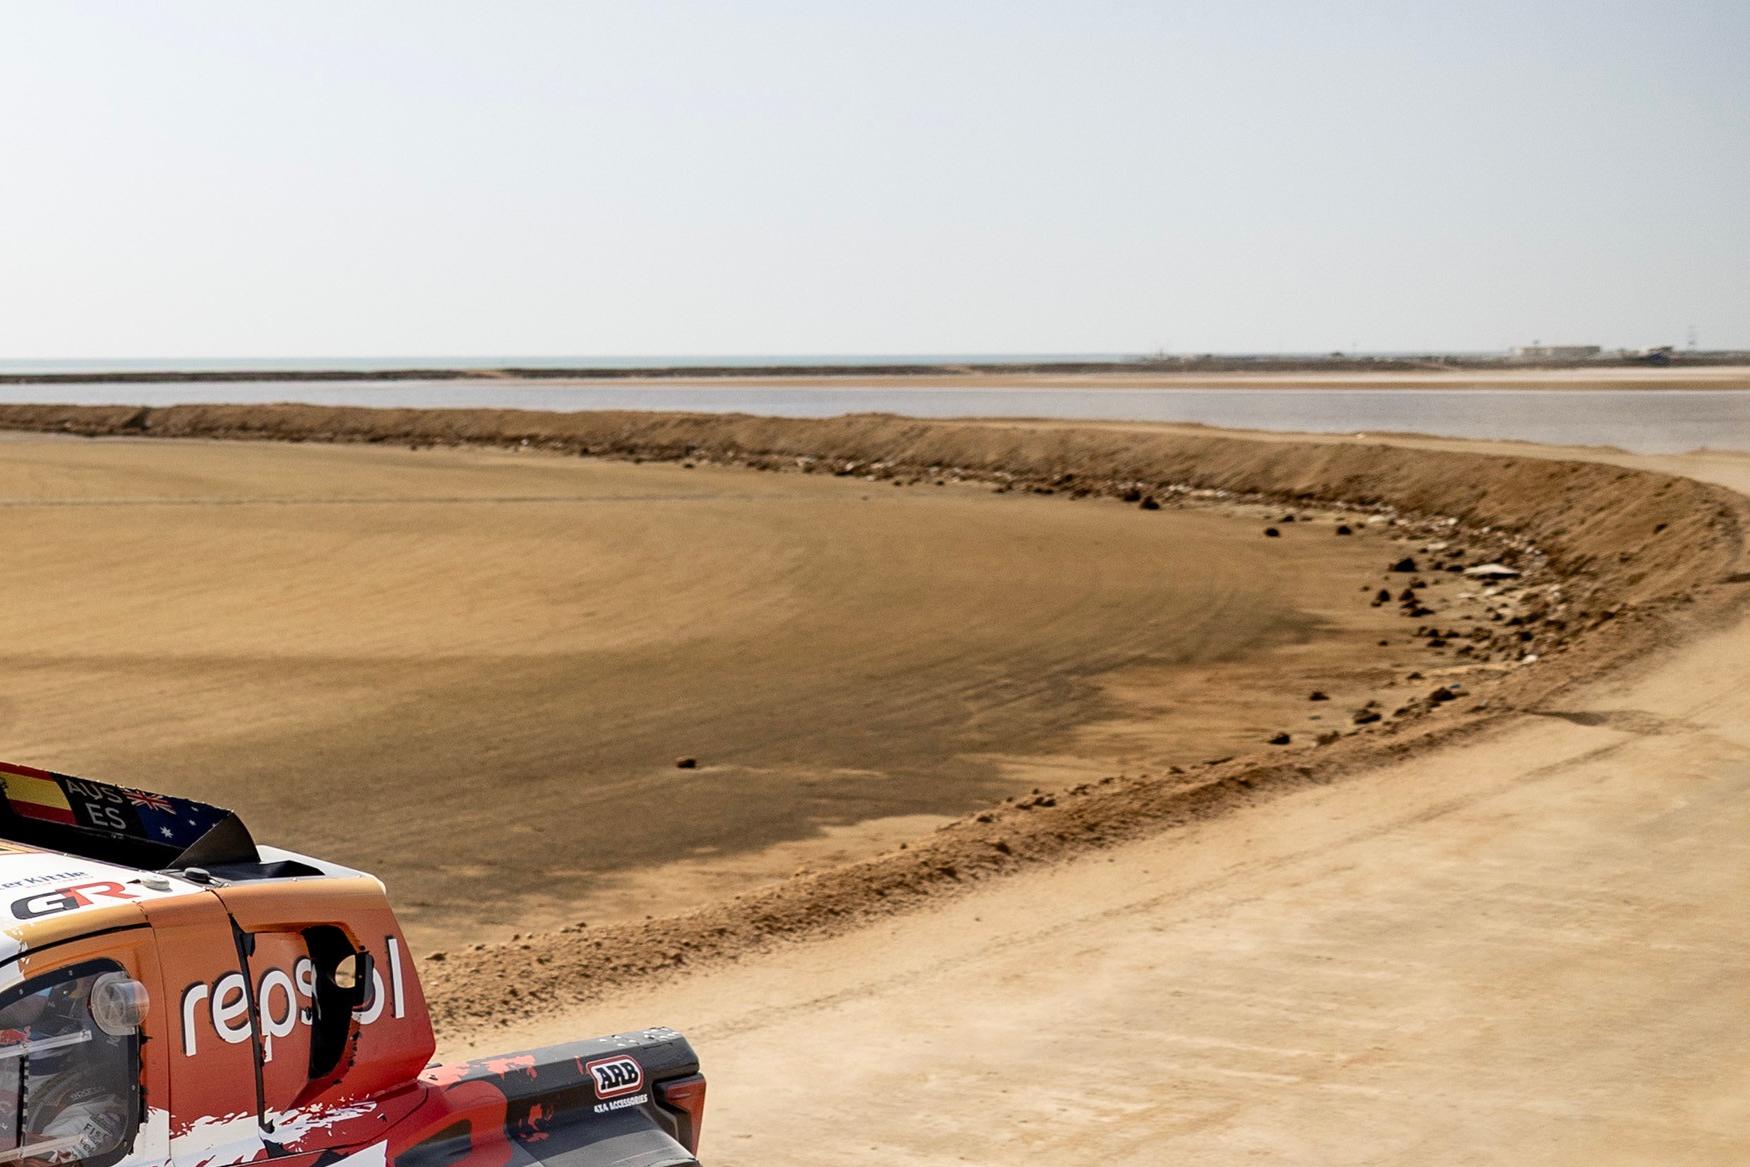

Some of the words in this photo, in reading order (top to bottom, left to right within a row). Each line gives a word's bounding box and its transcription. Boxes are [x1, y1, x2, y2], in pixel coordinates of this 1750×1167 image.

[65, 779, 123, 804] AUS
[85, 803, 127, 830] ES
[10, 881, 142, 920] GR
[594, 1061, 640, 1091] ARB
[609, 1093, 649, 1111] ACCESSORIES
